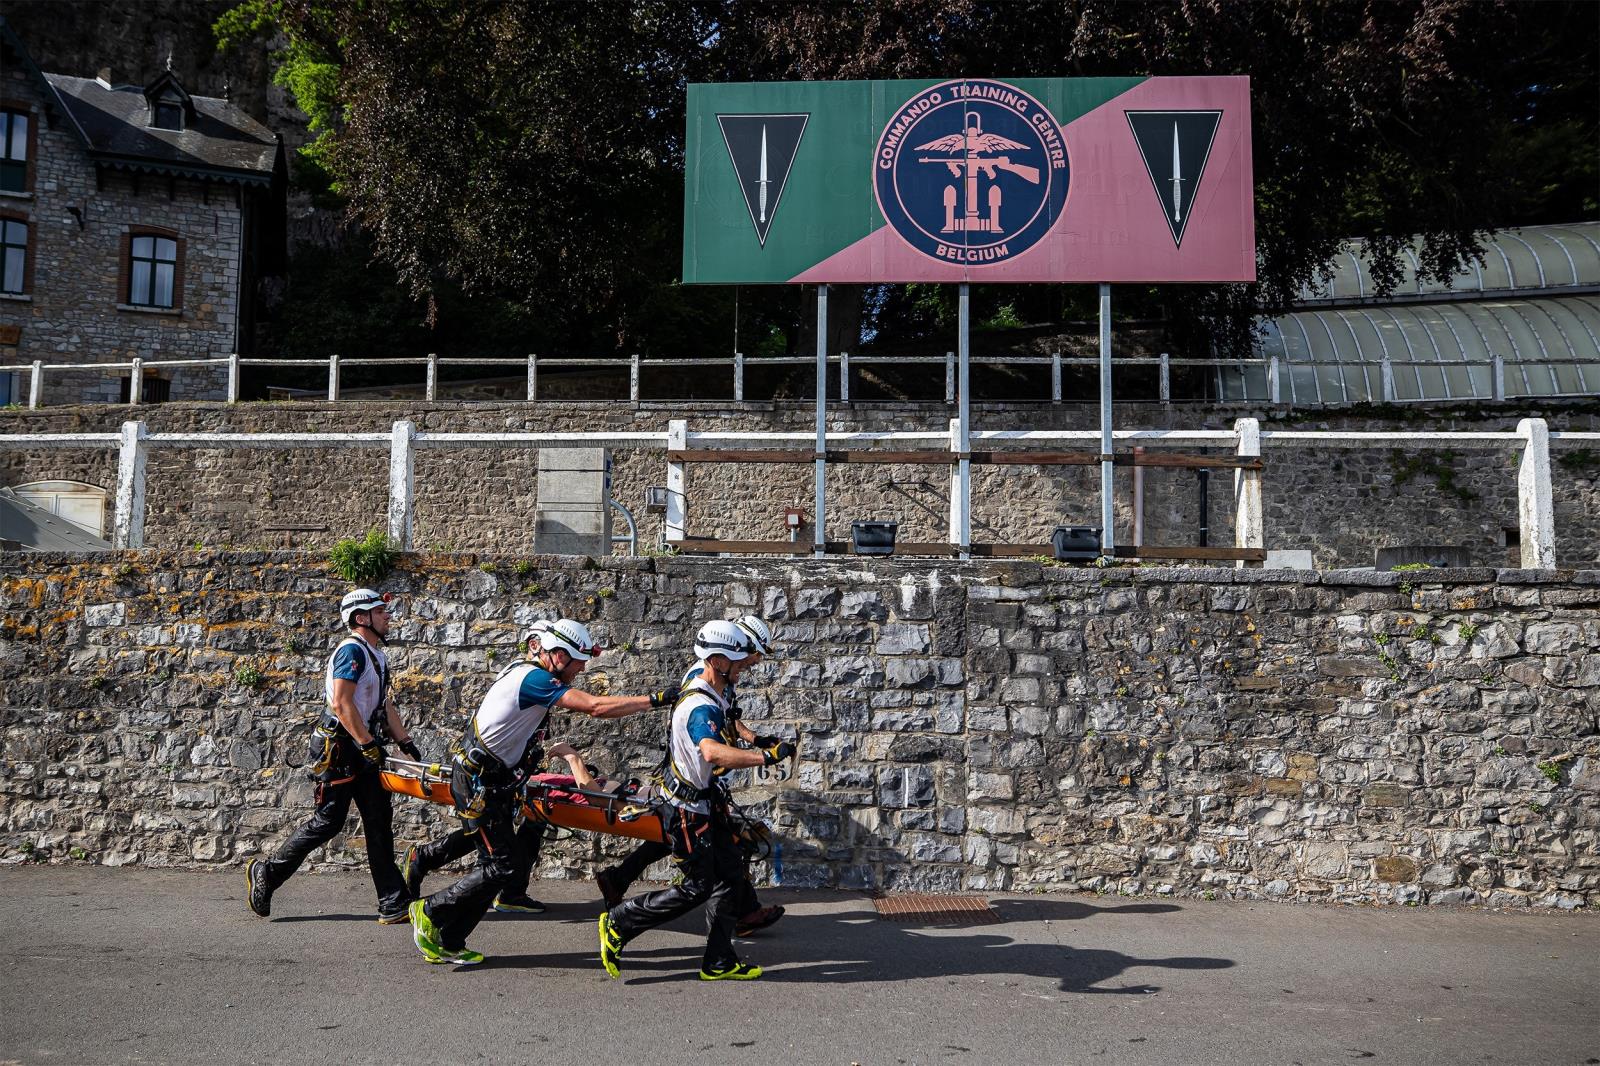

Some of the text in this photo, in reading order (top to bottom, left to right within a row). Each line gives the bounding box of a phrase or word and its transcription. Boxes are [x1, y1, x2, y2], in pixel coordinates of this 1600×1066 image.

[879, 84, 1066, 170] COMMANDO TRAINING CENTRE
[935, 243, 1009, 262] BELGIUM
